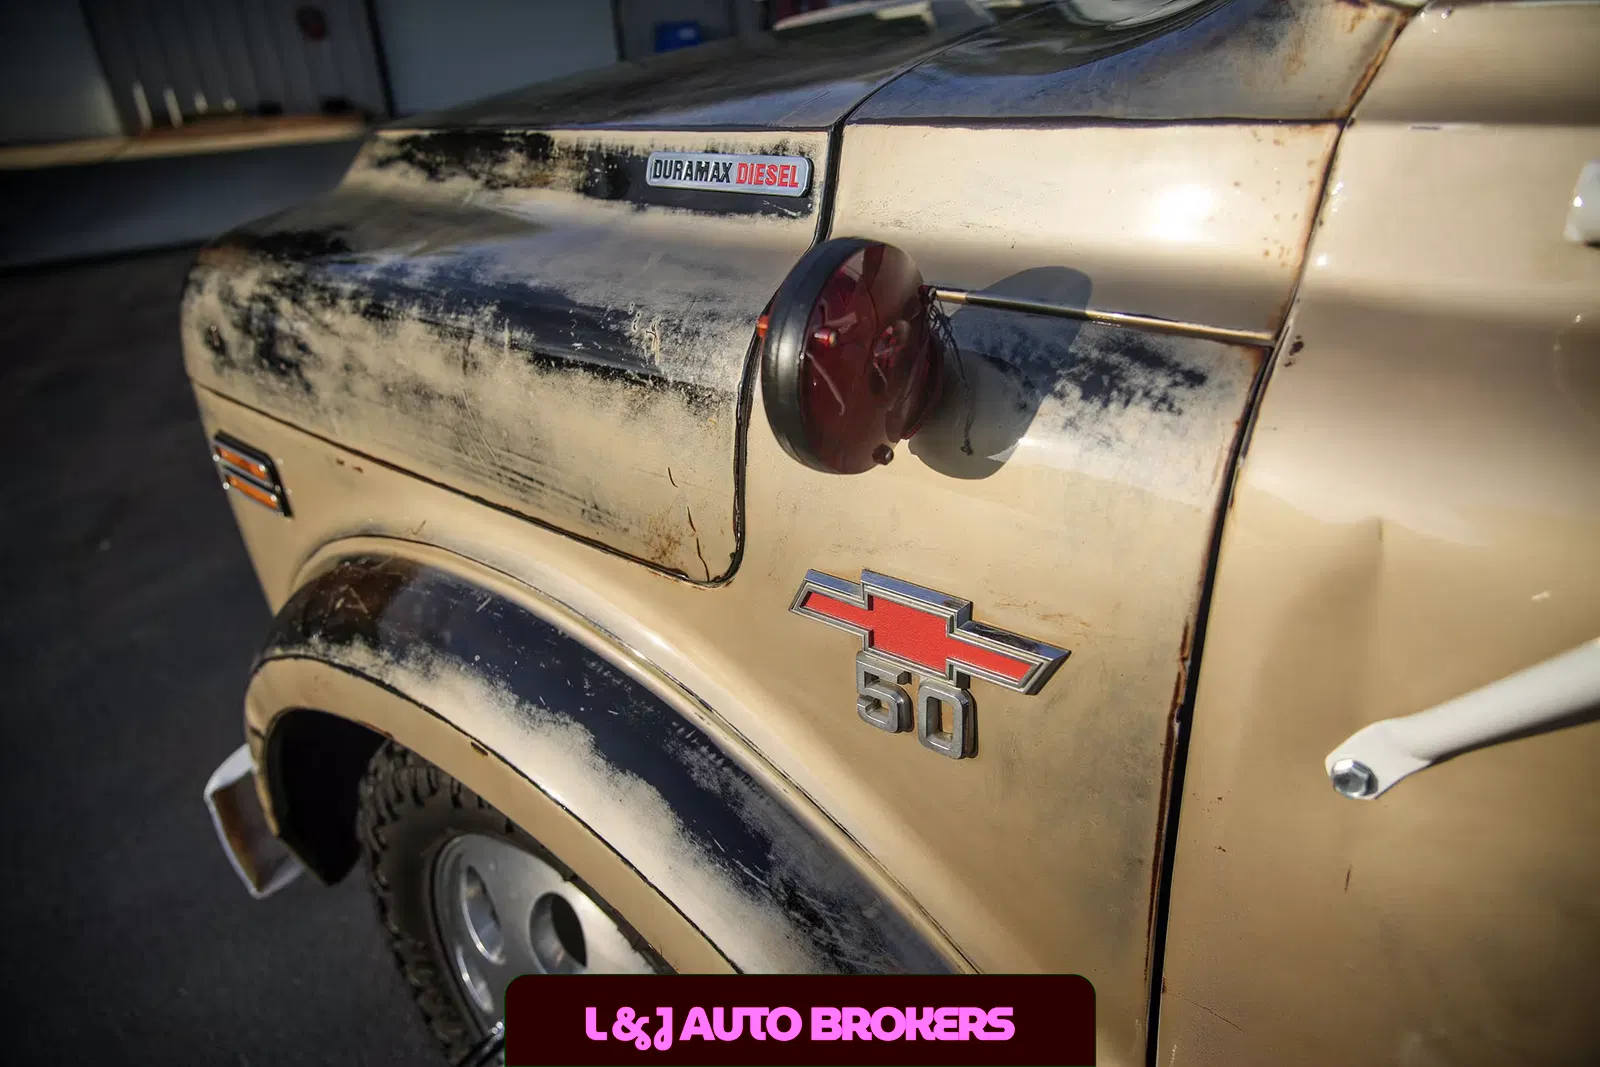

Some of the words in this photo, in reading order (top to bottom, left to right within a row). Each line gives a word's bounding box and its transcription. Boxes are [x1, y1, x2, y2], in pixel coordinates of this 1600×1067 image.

[652, 159, 733, 183] DURAMAX
[736, 162, 799, 188] DIESEL
[855, 650, 976, 760] 50
